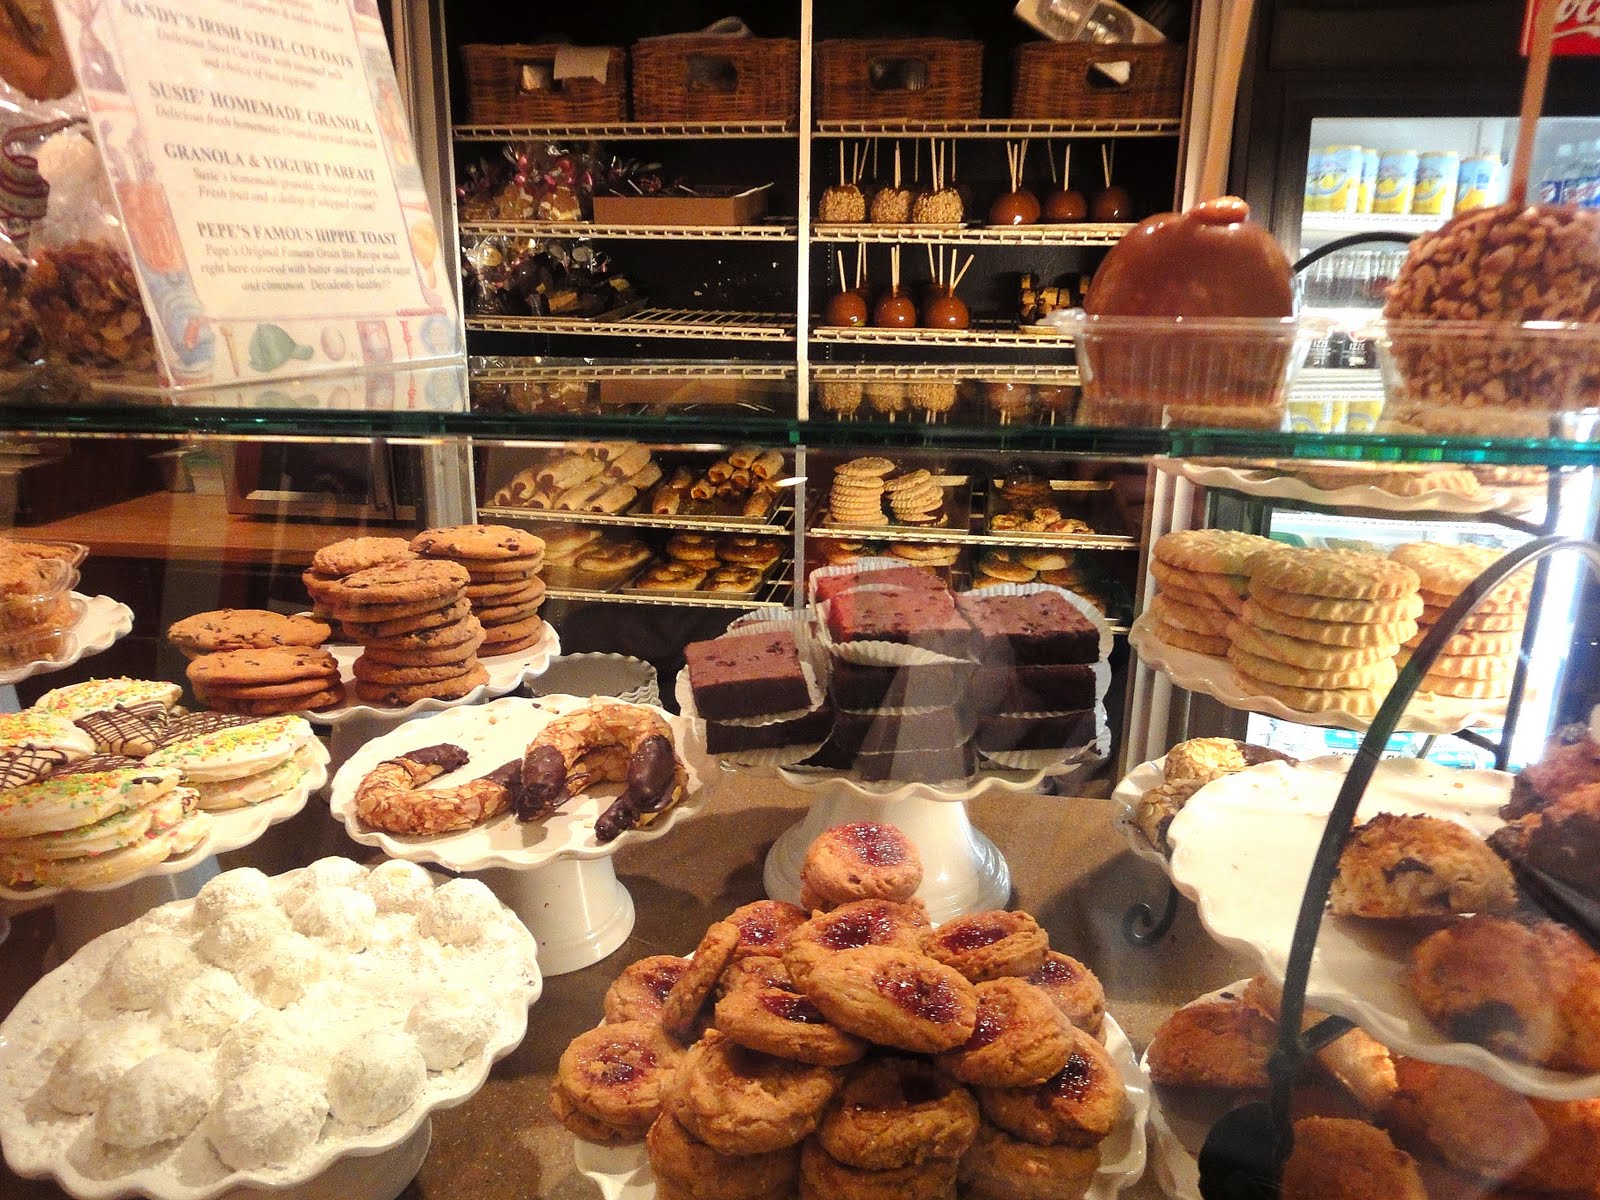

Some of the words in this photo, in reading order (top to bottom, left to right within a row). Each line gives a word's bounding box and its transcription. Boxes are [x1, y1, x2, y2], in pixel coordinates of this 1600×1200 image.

[199, 17, 241, 41] IRISH
[243, 29, 290, 53] STEEL
[210, 91, 304, 122] HOMEMADE
[306, 110, 373, 134] GRANOLA
[163, 143, 246, 168] GRANOLA
[249, 153, 261, 168] &
[262, 155, 320, 176] YOGURT
[322, 163, 376, 182] PARFAIT
[196, 221, 251, 239] PEPE'S
[253, 224, 314, 241] FAMOUS
[314, 228, 358, 244] HIPPIE
[360, 230, 398, 245] TOAST
[240, 244, 280, 260] Original
[200, 262, 225, 277] right
[226, 262, 249, 274] here
[250, 263, 286, 275] covered
[287, 263, 307, 274] with
[349, 264, 375, 277] topped
[1349, 342, 1366, 350] IZZE
